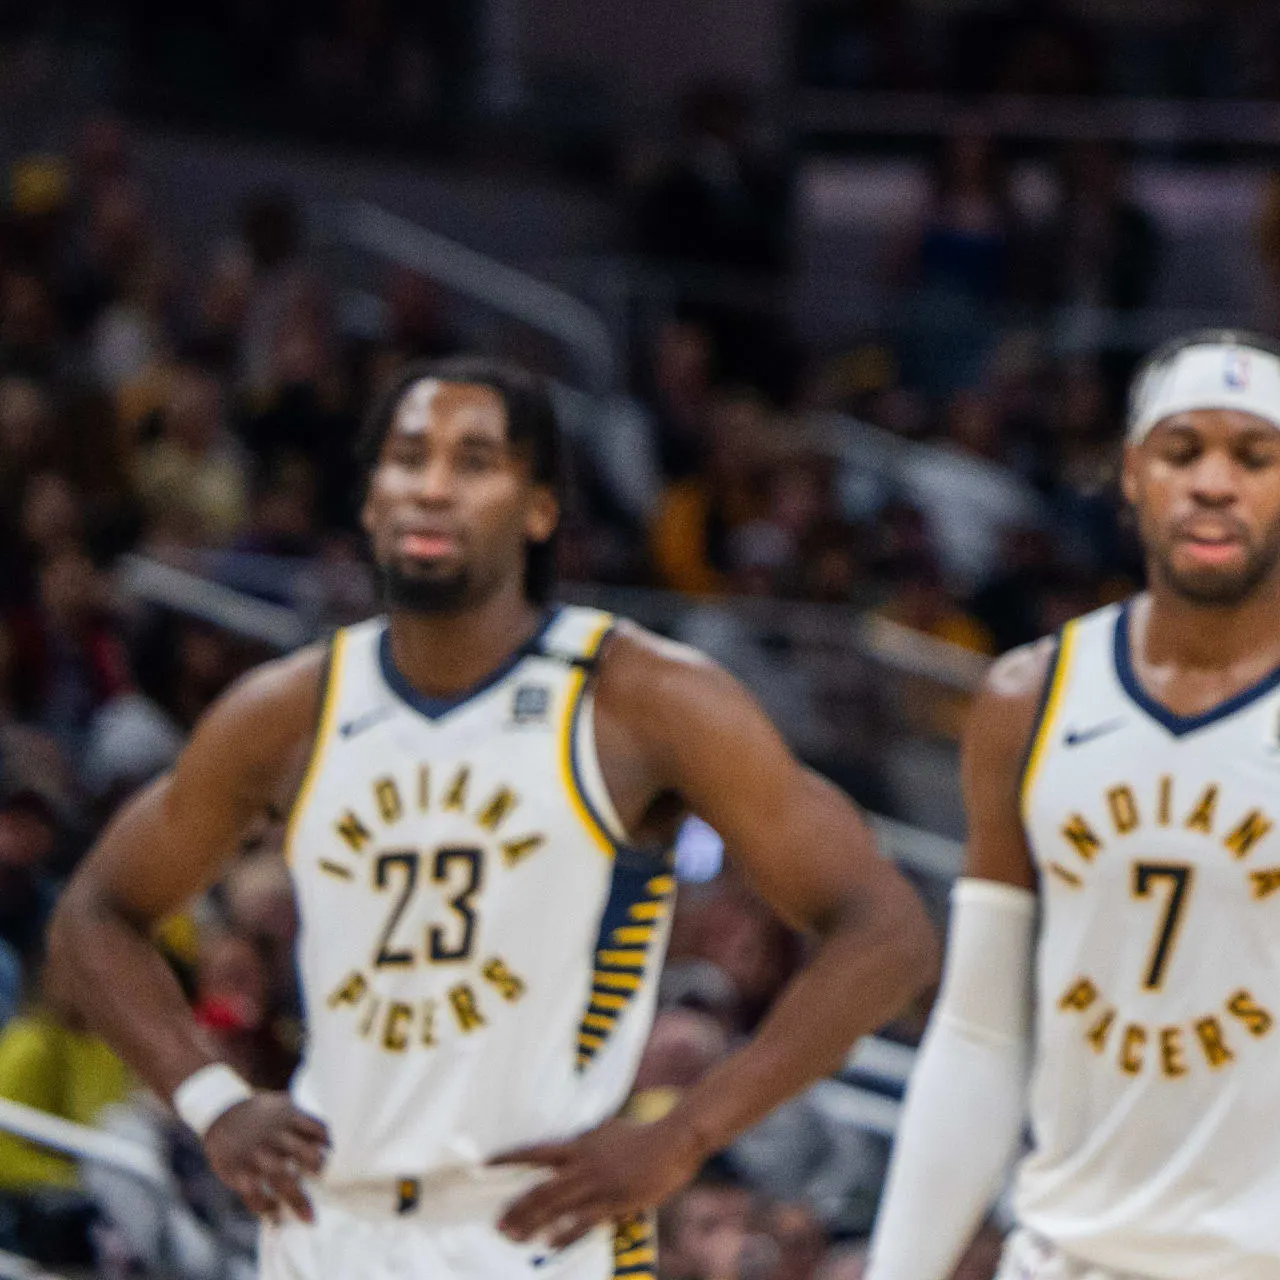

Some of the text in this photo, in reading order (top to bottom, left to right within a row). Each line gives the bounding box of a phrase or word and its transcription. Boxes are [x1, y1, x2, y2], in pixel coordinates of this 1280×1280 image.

[316, 761, 546, 882] INDIANA
[373, 844, 485, 969] 23
[1131, 860, 1193, 992] 7
[1058, 975, 1274, 1079] PACERS
